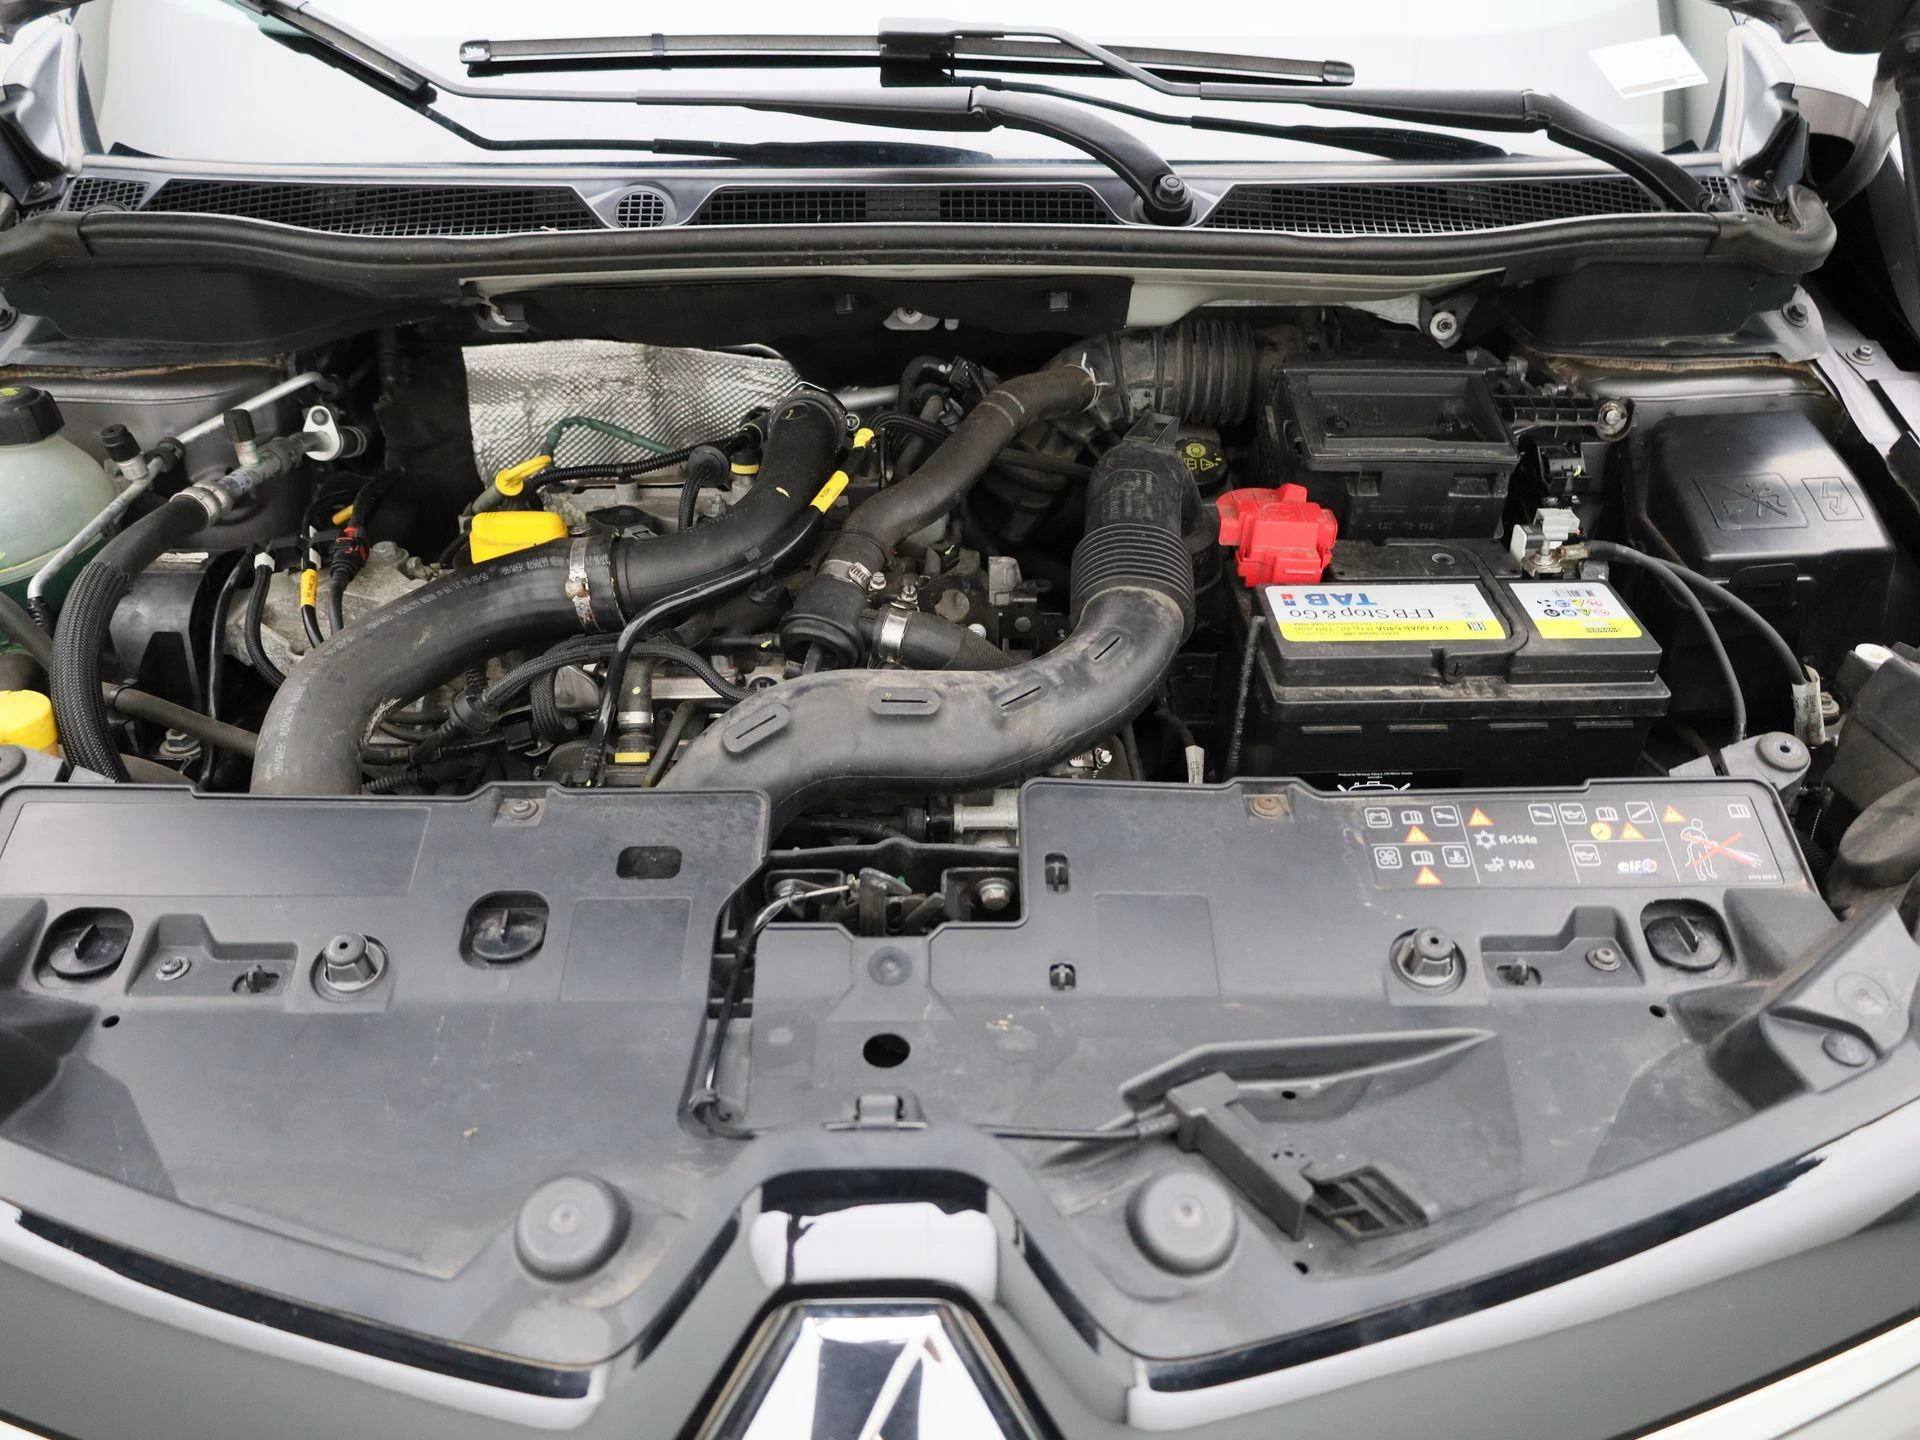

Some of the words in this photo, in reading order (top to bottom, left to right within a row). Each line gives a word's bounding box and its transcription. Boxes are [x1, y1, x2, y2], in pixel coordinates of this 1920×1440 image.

[1304, 592, 1377, 606] TAB
[1288, 609, 1318, 620] Go
[1340, 606, 1389, 619] Stop
[1393, 607, 1434, 619] EFB
[1498, 834, 1539, 845] R-134a
[1508, 859, 1536, 870] PAG
